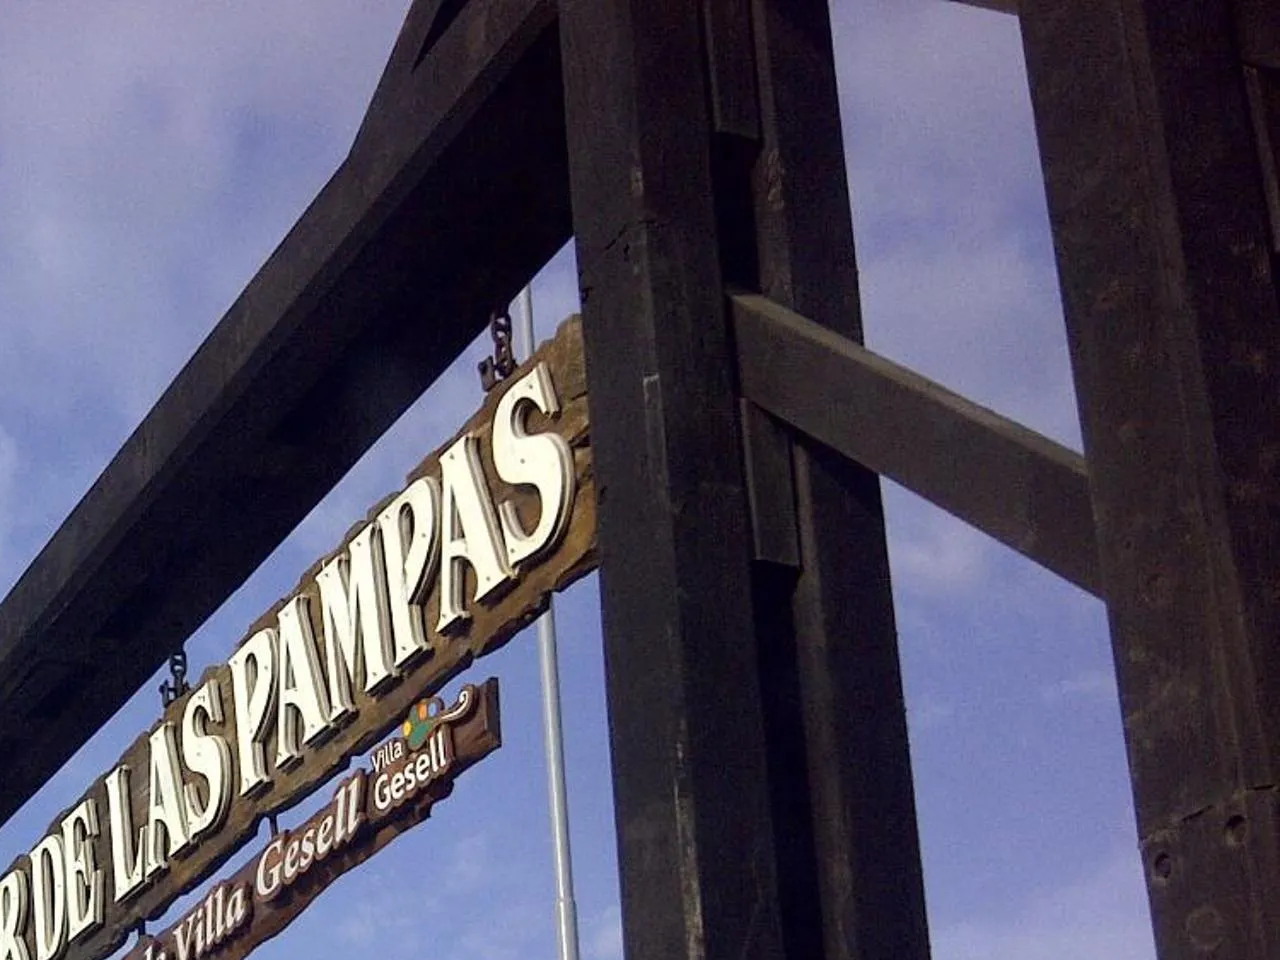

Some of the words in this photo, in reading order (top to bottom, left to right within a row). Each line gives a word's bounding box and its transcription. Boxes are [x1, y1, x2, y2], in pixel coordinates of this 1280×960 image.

[105, 679, 231, 902] LAS
[228, 362, 575, 797] PAMPAS
[371, 737, 404, 773] Villa
[373, 737, 449, 811] Gesell
[256, 777, 362, 898] Gesell
